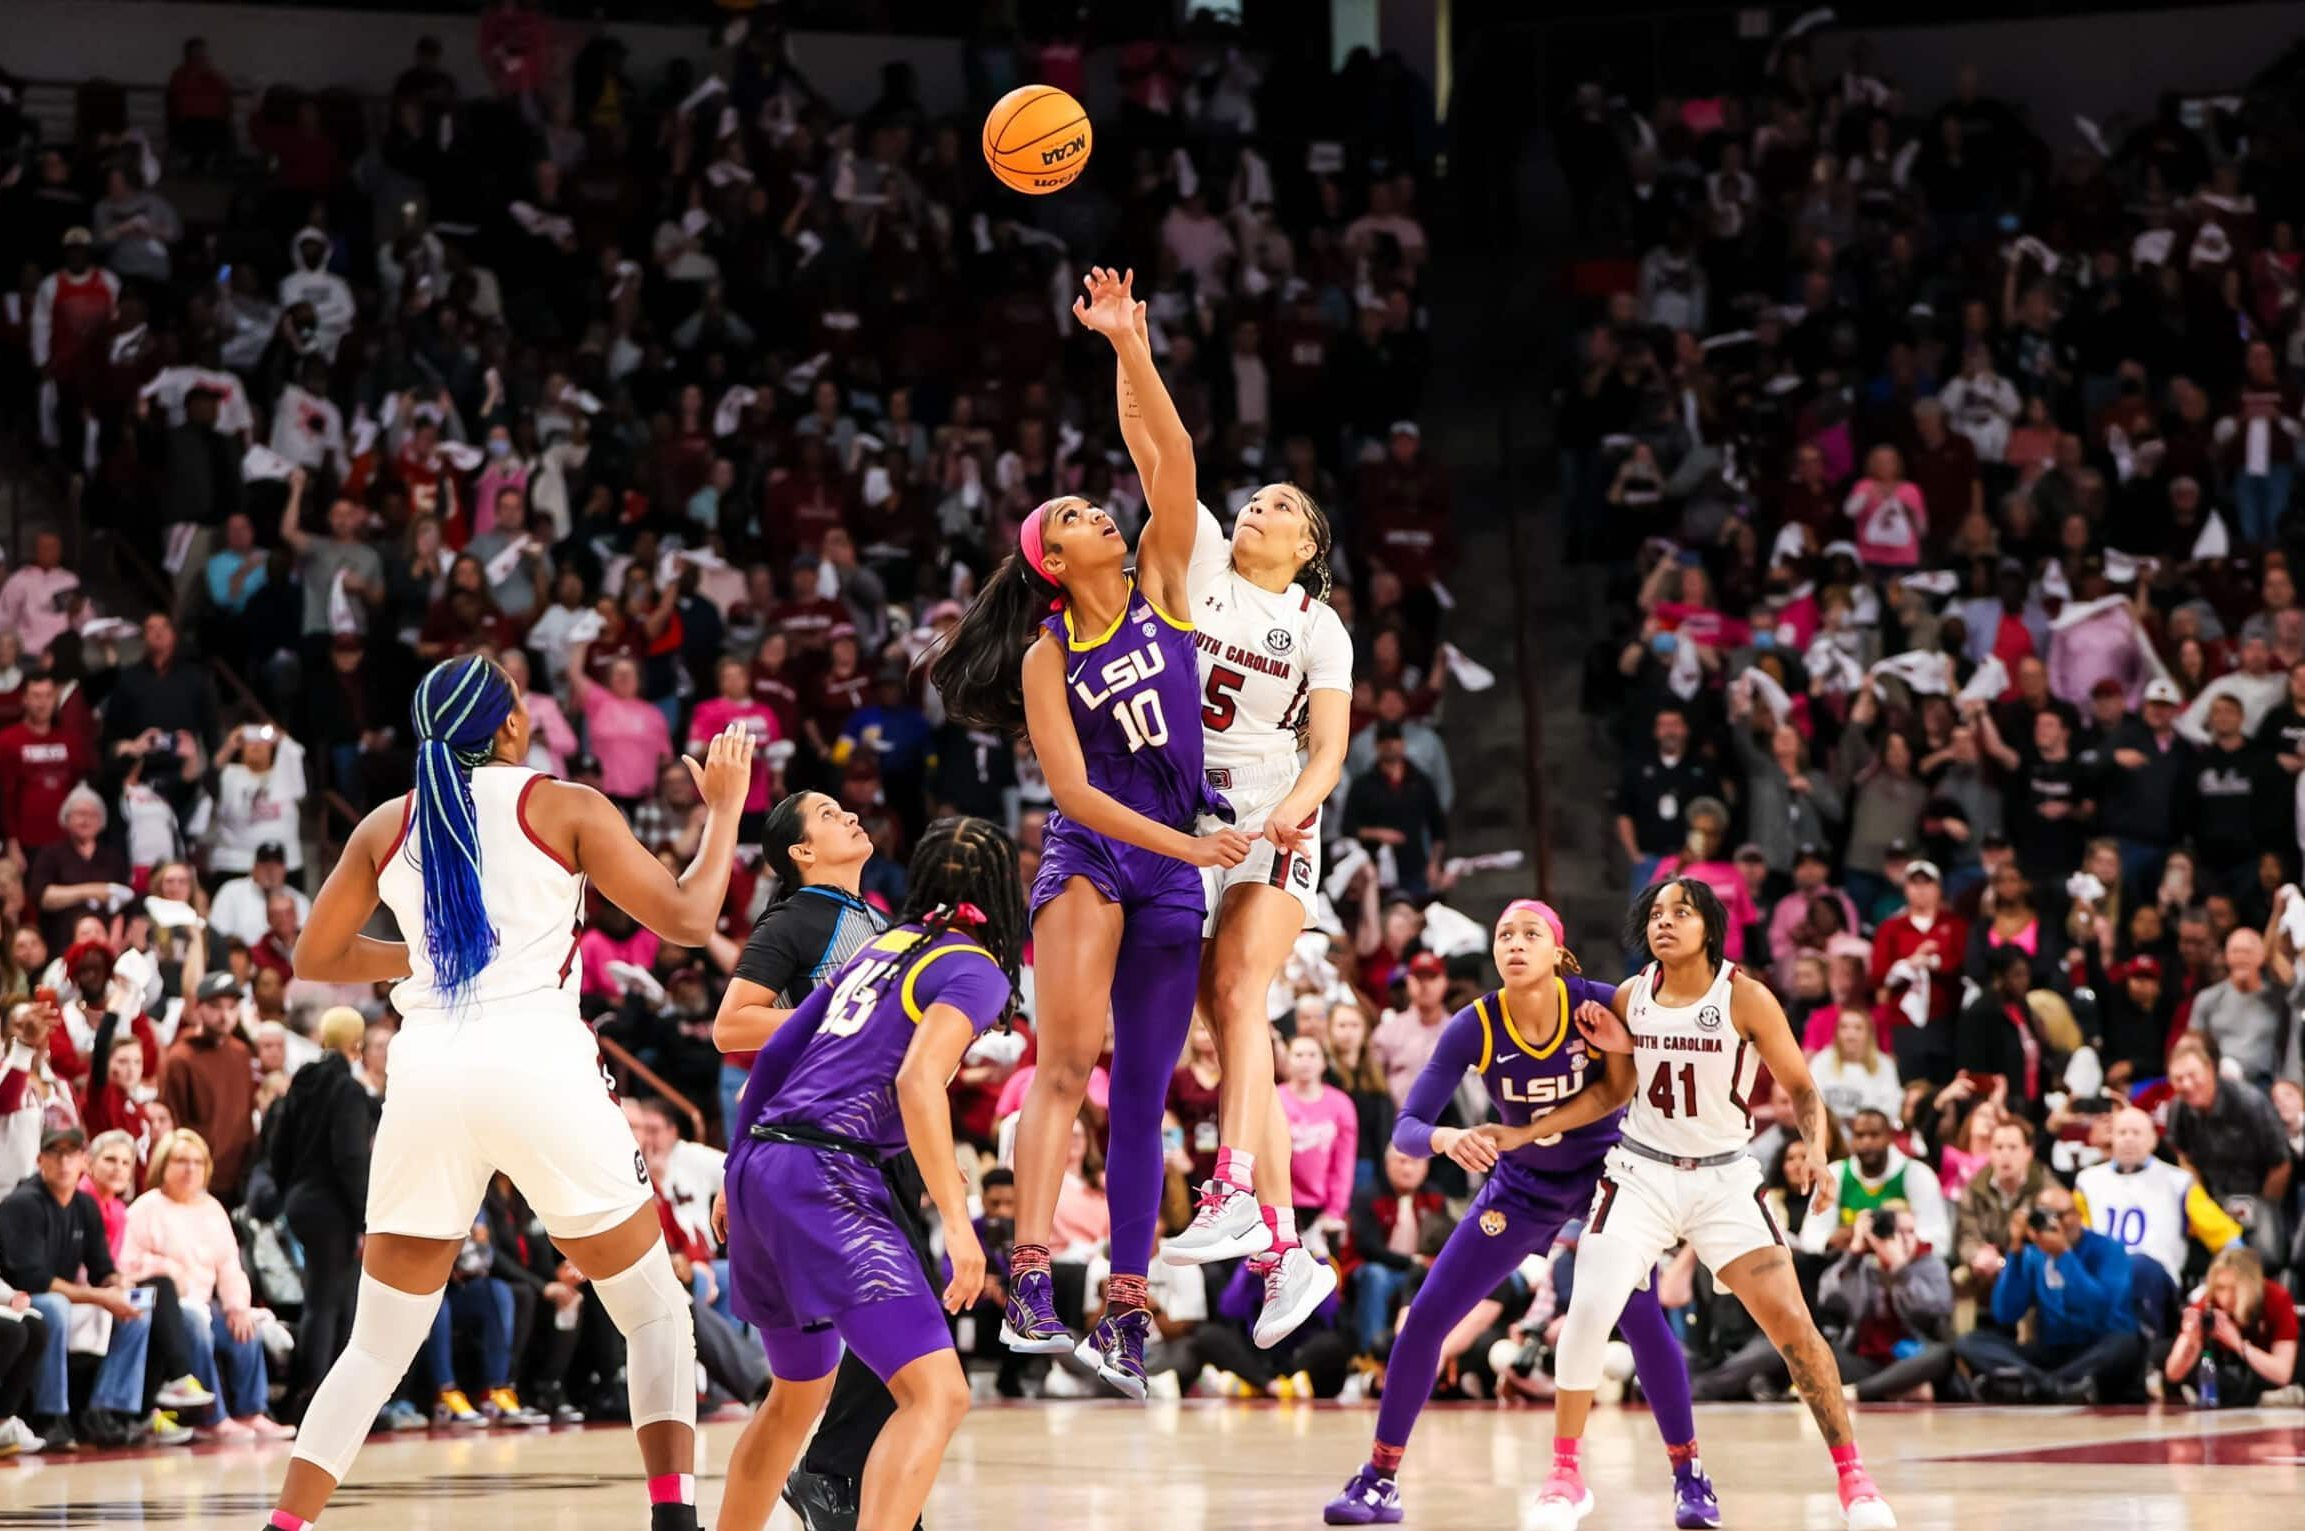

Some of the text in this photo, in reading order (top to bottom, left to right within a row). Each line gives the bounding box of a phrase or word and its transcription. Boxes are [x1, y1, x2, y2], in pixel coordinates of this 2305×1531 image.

[1041, 133, 1086, 166] NCAA
[1268, 629, 1291, 650] SEC
[1074, 641, 1166, 711] LSU
[1225, 645, 1291, 680] CAROLINA
[1201, 664, 1246, 733] 5
[1112, 688, 1169, 754] 10
[816, 957, 900, 1038] 45
[1663, 1035, 1723, 1053] CAROLINA
[1501, 1070, 1584, 1103] LSU
[1647, 1061, 1698, 1119] 41
[2107, 1205, 2146, 1246] 10
